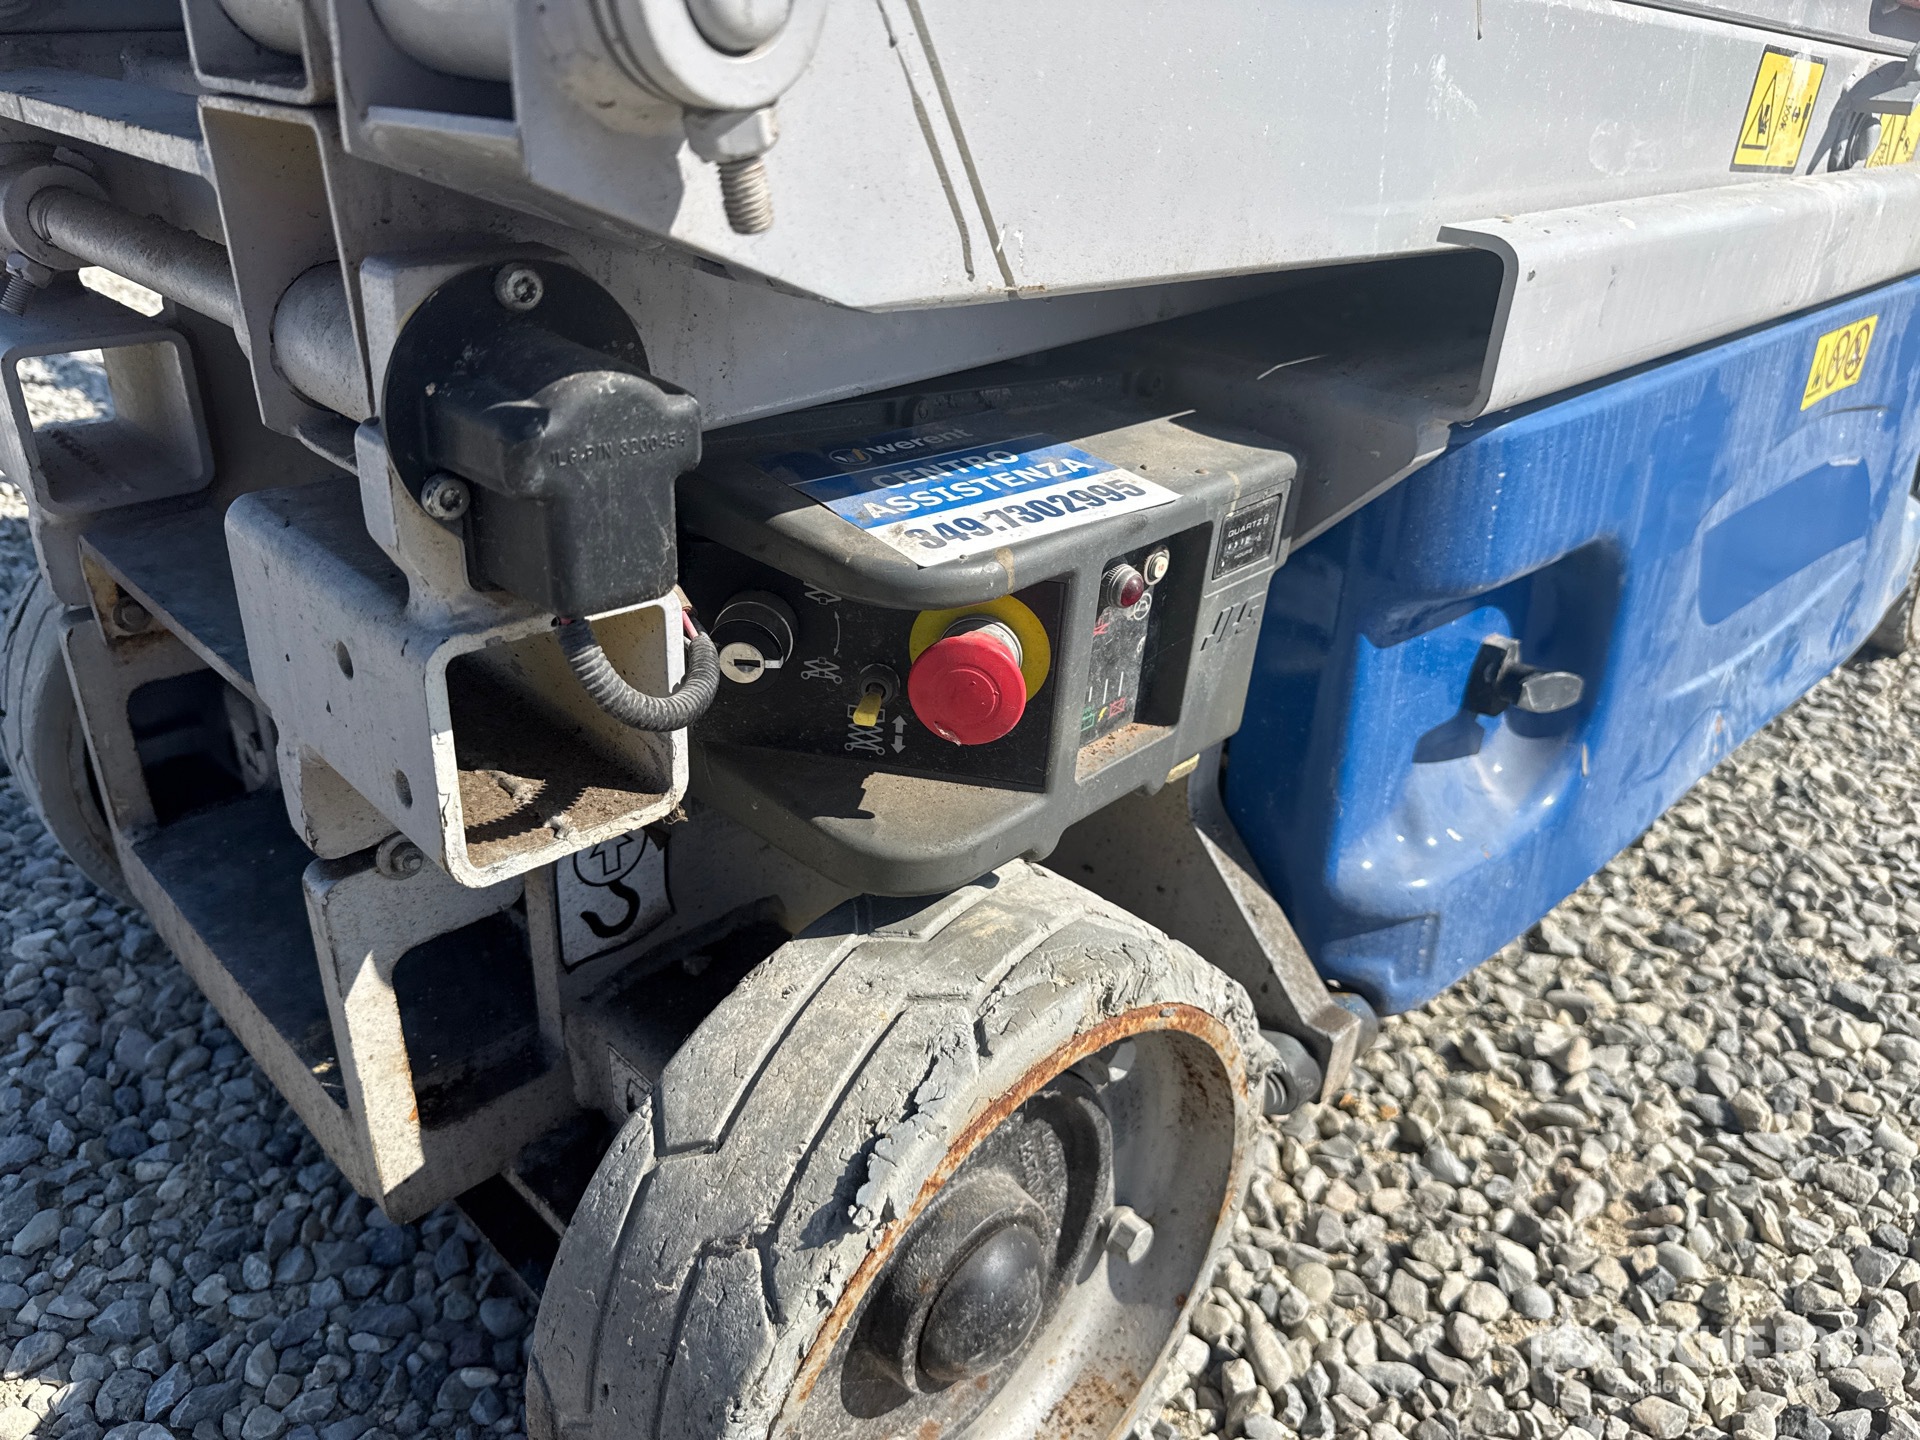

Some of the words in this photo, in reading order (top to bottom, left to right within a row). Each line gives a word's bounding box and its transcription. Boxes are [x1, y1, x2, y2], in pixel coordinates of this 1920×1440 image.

[866, 428, 973, 455] werent
[863, 458, 1094, 519] ASSISTENZA
[872, 450, 1019, 490] CENTRO
[904, 478, 1147, 549] 349.7302995
[1227, 517, 1263, 538] QUARTZ
